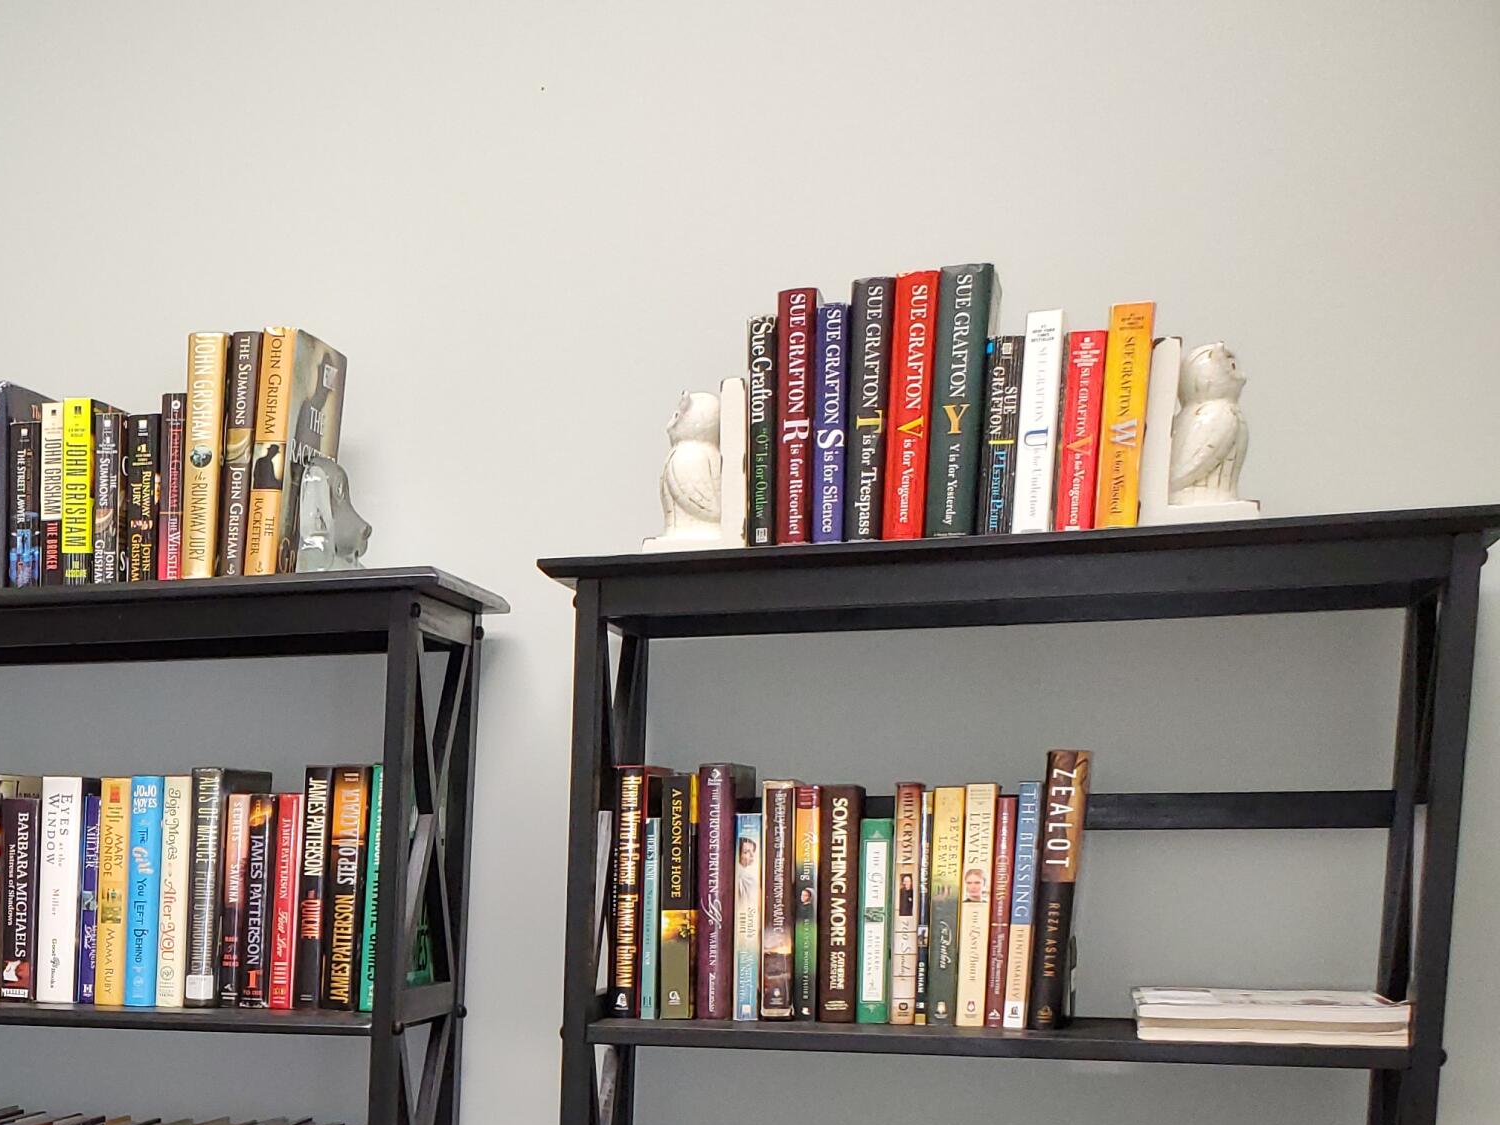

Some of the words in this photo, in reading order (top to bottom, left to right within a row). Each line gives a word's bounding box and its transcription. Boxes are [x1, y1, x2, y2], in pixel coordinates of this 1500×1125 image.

[867, 285, 883, 320] SUE
[910, 284, 928, 320] SUE
[955, 274, 973, 308] SUE
[789, 293, 806, 328] SUE
[826, 308, 842, 341] SUE
[194, 334, 216, 374] JOHN
[239, 336, 251, 360] THE
[271, 333, 285, 370] JOHN
[751, 322, 774, 355] Sue
[949, 311, 970, 398] GRAFTON
[788, 331, 805, 413] GRAFTON
[824, 344, 841, 425] GRAFTON
[862, 323, 881, 409] GRAFTON
[905, 322, 925, 410] GRAFTON
[235, 363, 252, 425] SUMMONS
[264, 373, 282, 434] GRISHAM
[751, 357, 773, 424] Grafton
[192, 380, 213, 447] GRISHAM
[782, 418, 810, 442] R
[856, 410, 885, 434] T
[897, 418, 924, 438] V
[942, 403, 970, 434] Y
[792, 444, 803, 456] is
[817, 429, 844, 449] S
[825, 451, 839, 461] is
[860, 448, 873, 466] for
[862, 434, 873, 445] is
[66, 442, 87, 478] JOHN
[790, 459, 803, 476] for
[824, 465, 838, 484] for
[230, 466, 246, 500] JOHN
[854, 466, 878, 535] Trespass
[65, 483, 87, 548] GRISHAM
[789, 478, 804, 536] Ricochet
[822, 486, 838, 533] Silence
[227, 503, 243, 560] GRISHAM
[250, 497, 264, 555] RACKETEER
[265, 516, 276, 537] THE
[672, 788, 682, 797] A
[1021, 789, 1036, 820] THE
[672, 799, 682, 846] SEASON
[1045, 768, 1076, 868] ZEALOT
[16, 812, 30, 883] BARBARA
[102, 826, 113, 878] MONROE
[112, 833, 124, 868] MARY
[251, 834, 266, 876] JAMES
[671, 849, 681, 866] OF
[830, 798, 848, 894] SOMETHING
[670, 868, 681, 899] HOPE
[1014, 825, 1034, 918] BLESSING
[14, 885, 27, 958] MICHAELS
[246, 878, 263, 966] PATTERSON
[830, 898, 846, 946] MORE
